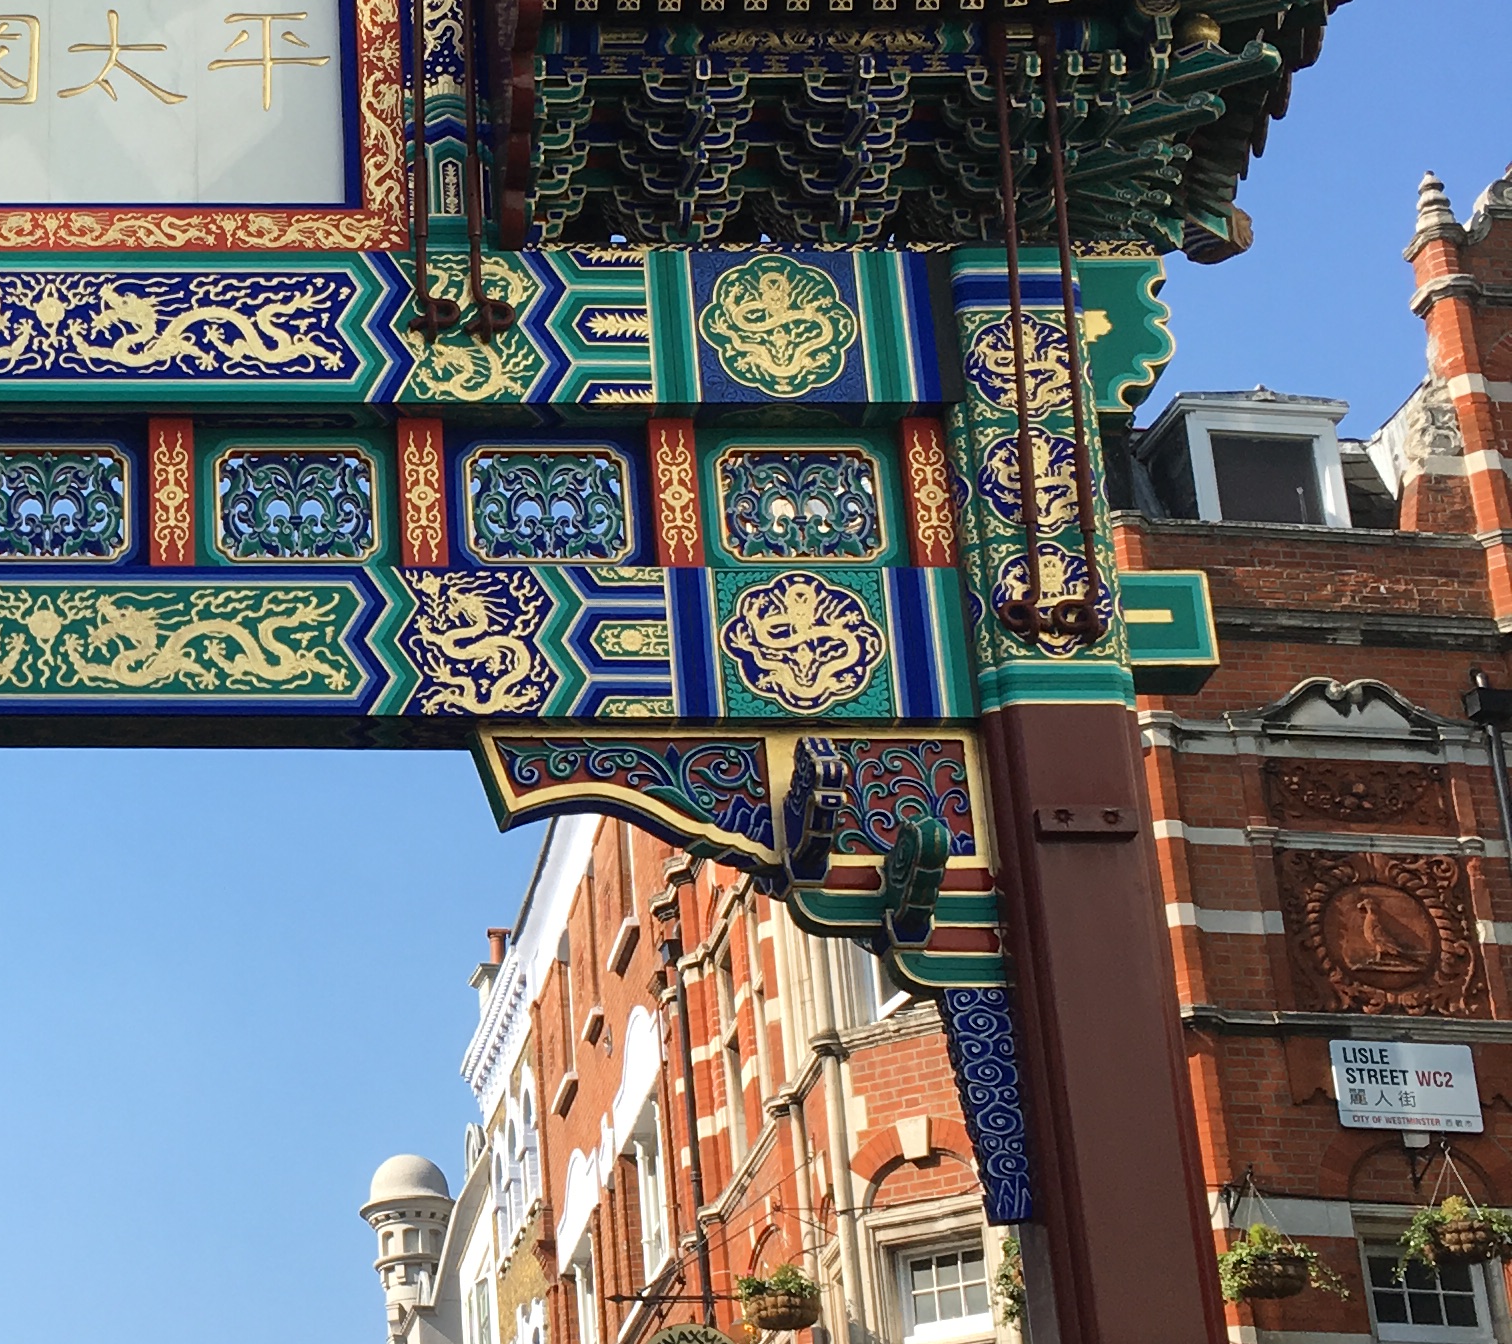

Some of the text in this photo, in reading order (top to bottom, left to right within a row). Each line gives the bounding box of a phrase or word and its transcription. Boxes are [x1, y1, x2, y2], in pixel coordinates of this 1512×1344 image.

[1342, 1047, 1390, 1065] LISLE
[1345, 1068, 1454, 1088] STREET WC2
[1352, 1114, 1441, 1127] CITY OF WESTMINSTER
